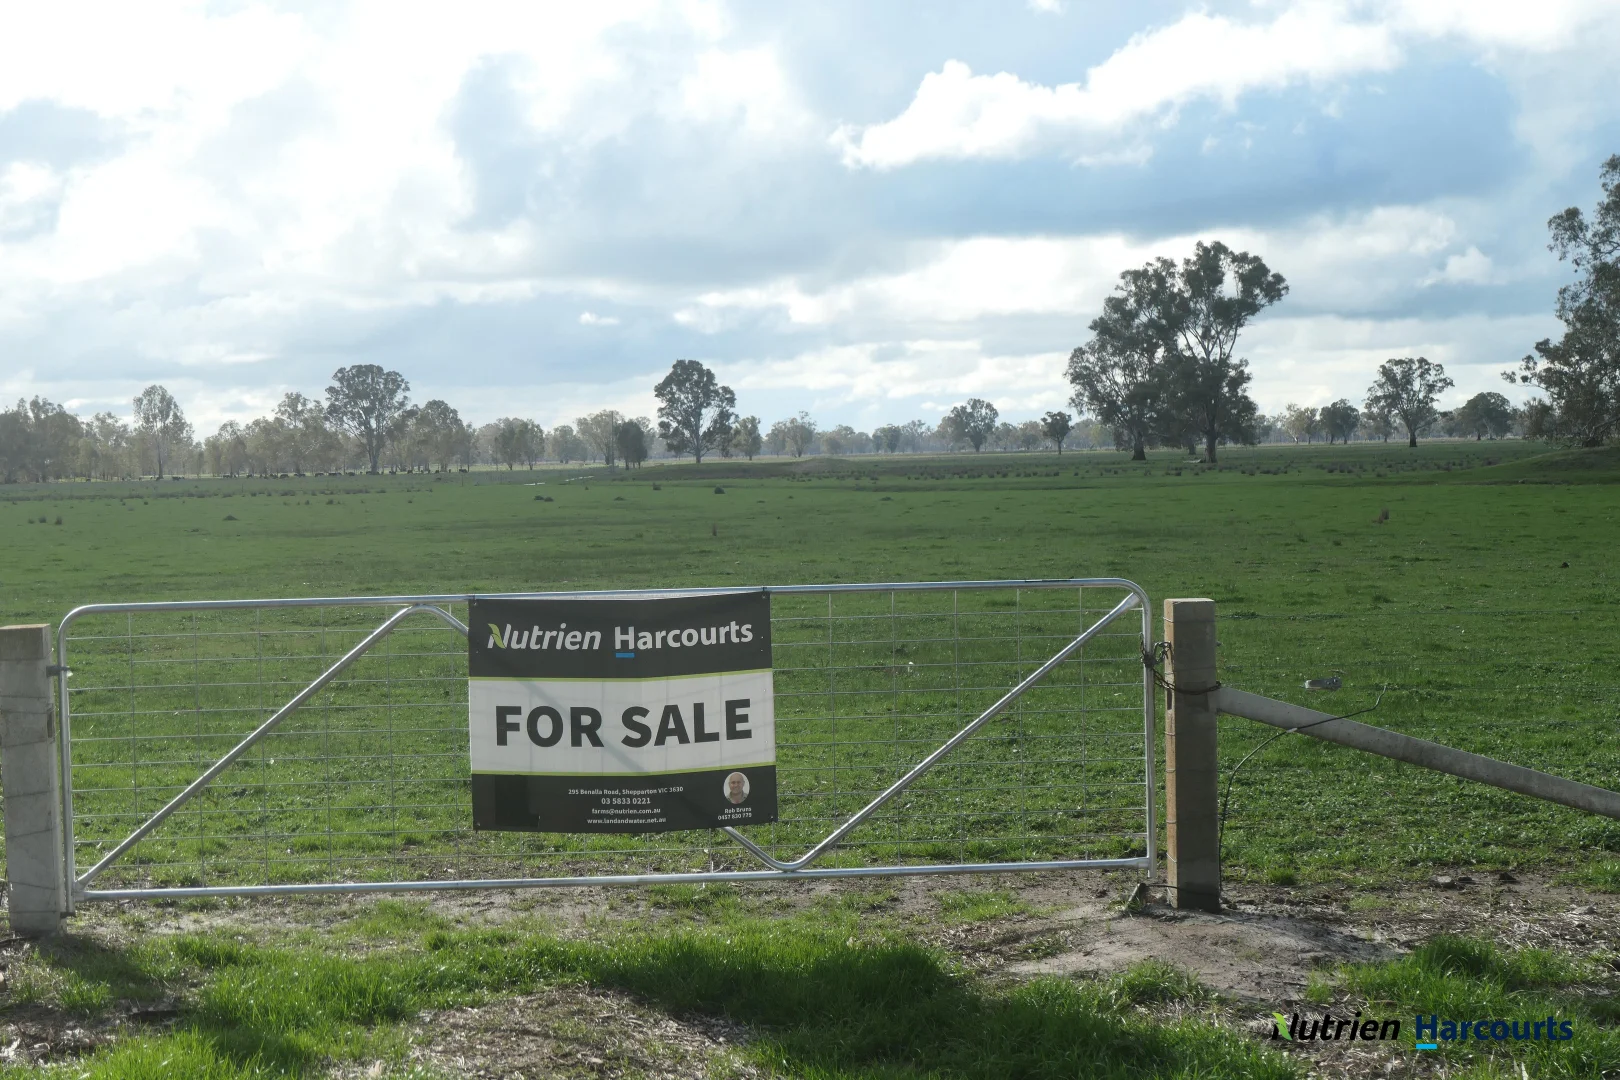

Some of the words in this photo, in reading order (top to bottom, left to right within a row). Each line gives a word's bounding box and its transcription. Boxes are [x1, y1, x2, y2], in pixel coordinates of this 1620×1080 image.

[487, 622, 602, 650] Nutrien
[614, 620, 754, 650] Harcourts
[495, 705, 604, 748] FOR
[621, 698, 753, 748] SALE
[603, 788, 621, 796] Road,
[622, 787, 657, 796] Shepparton
[601, 797, 611, 805] 03
[612, 797, 631, 805] 5833
[632, 797, 651, 805] 0221
[591, 807, 661, 815] farms@nutrien.com.au
